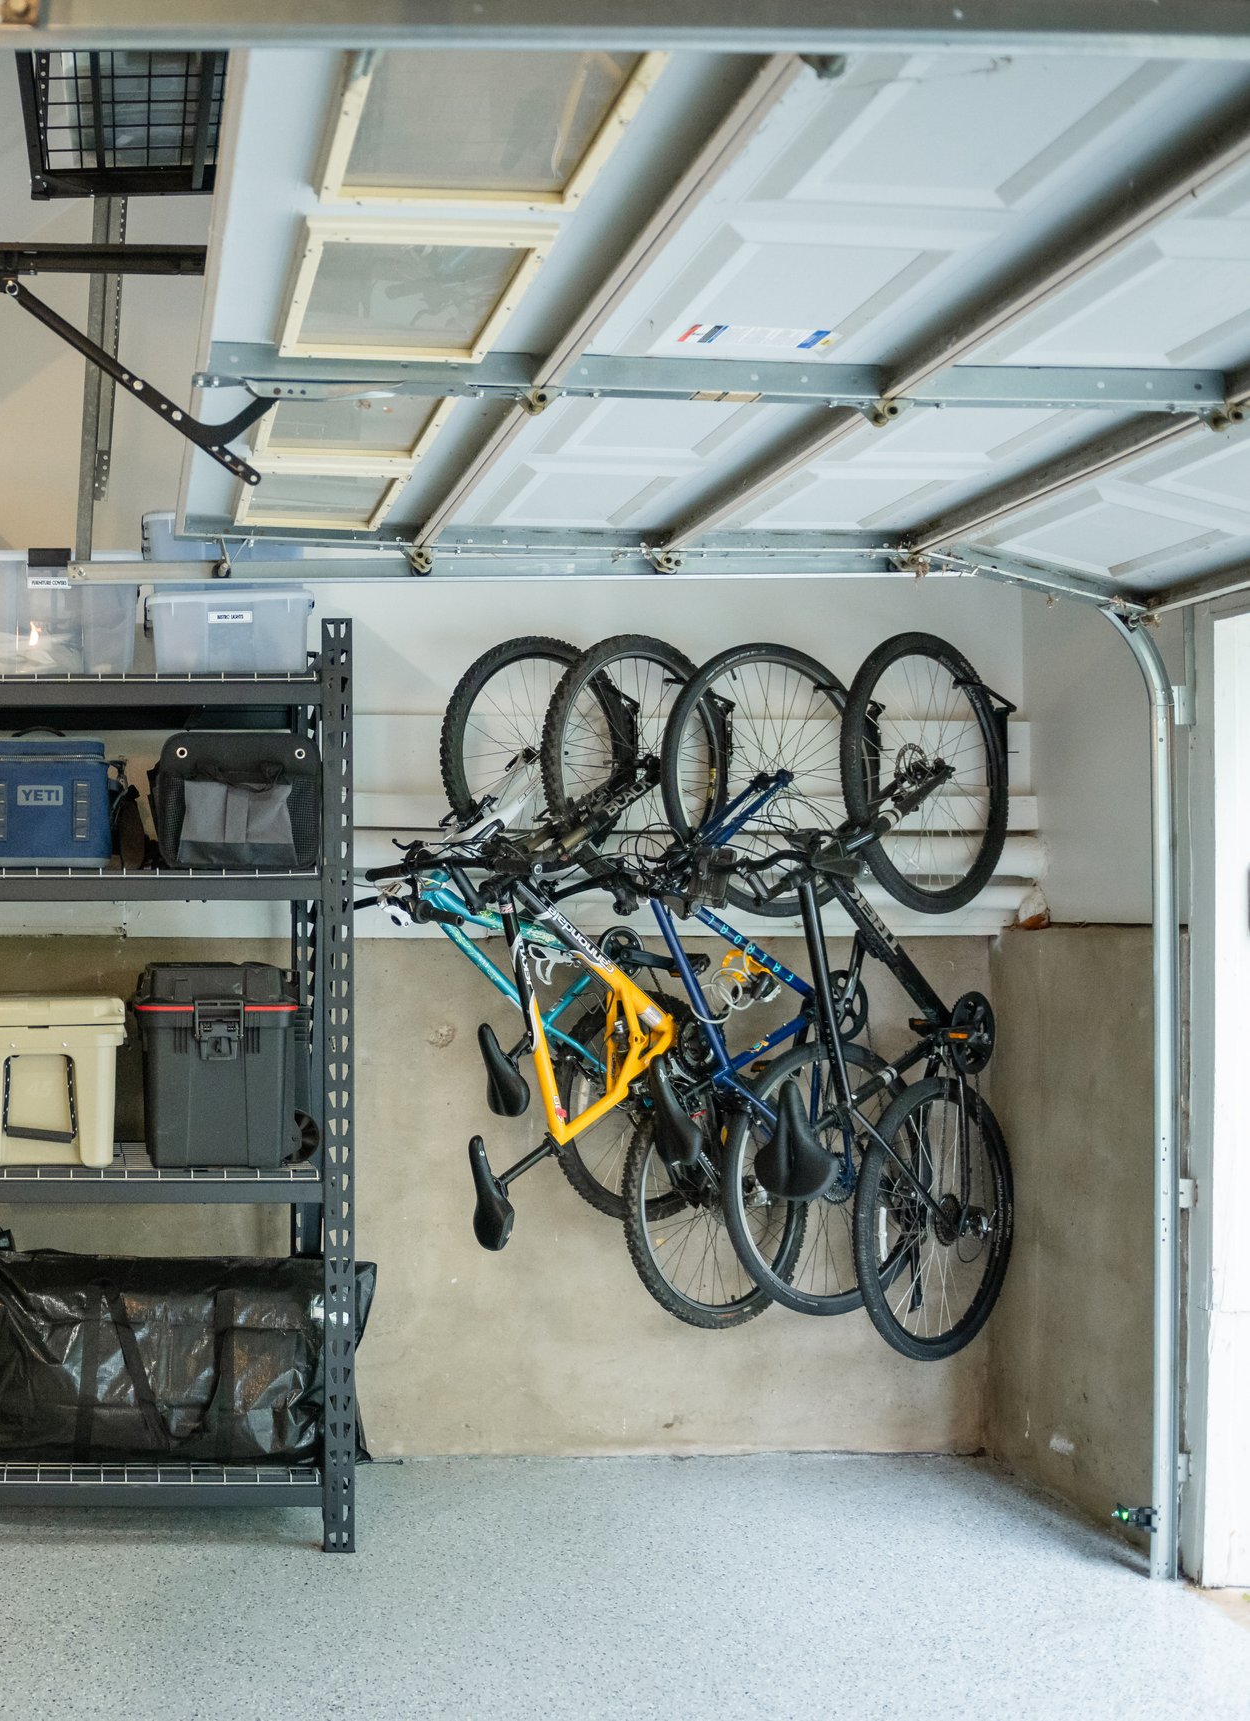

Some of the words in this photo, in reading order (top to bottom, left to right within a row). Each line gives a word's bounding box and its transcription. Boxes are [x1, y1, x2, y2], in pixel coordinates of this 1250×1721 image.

[22, 790, 60, 802] YETI
[548, 904, 615, 974] cannondale
[846, 885, 903, 955] TREK
